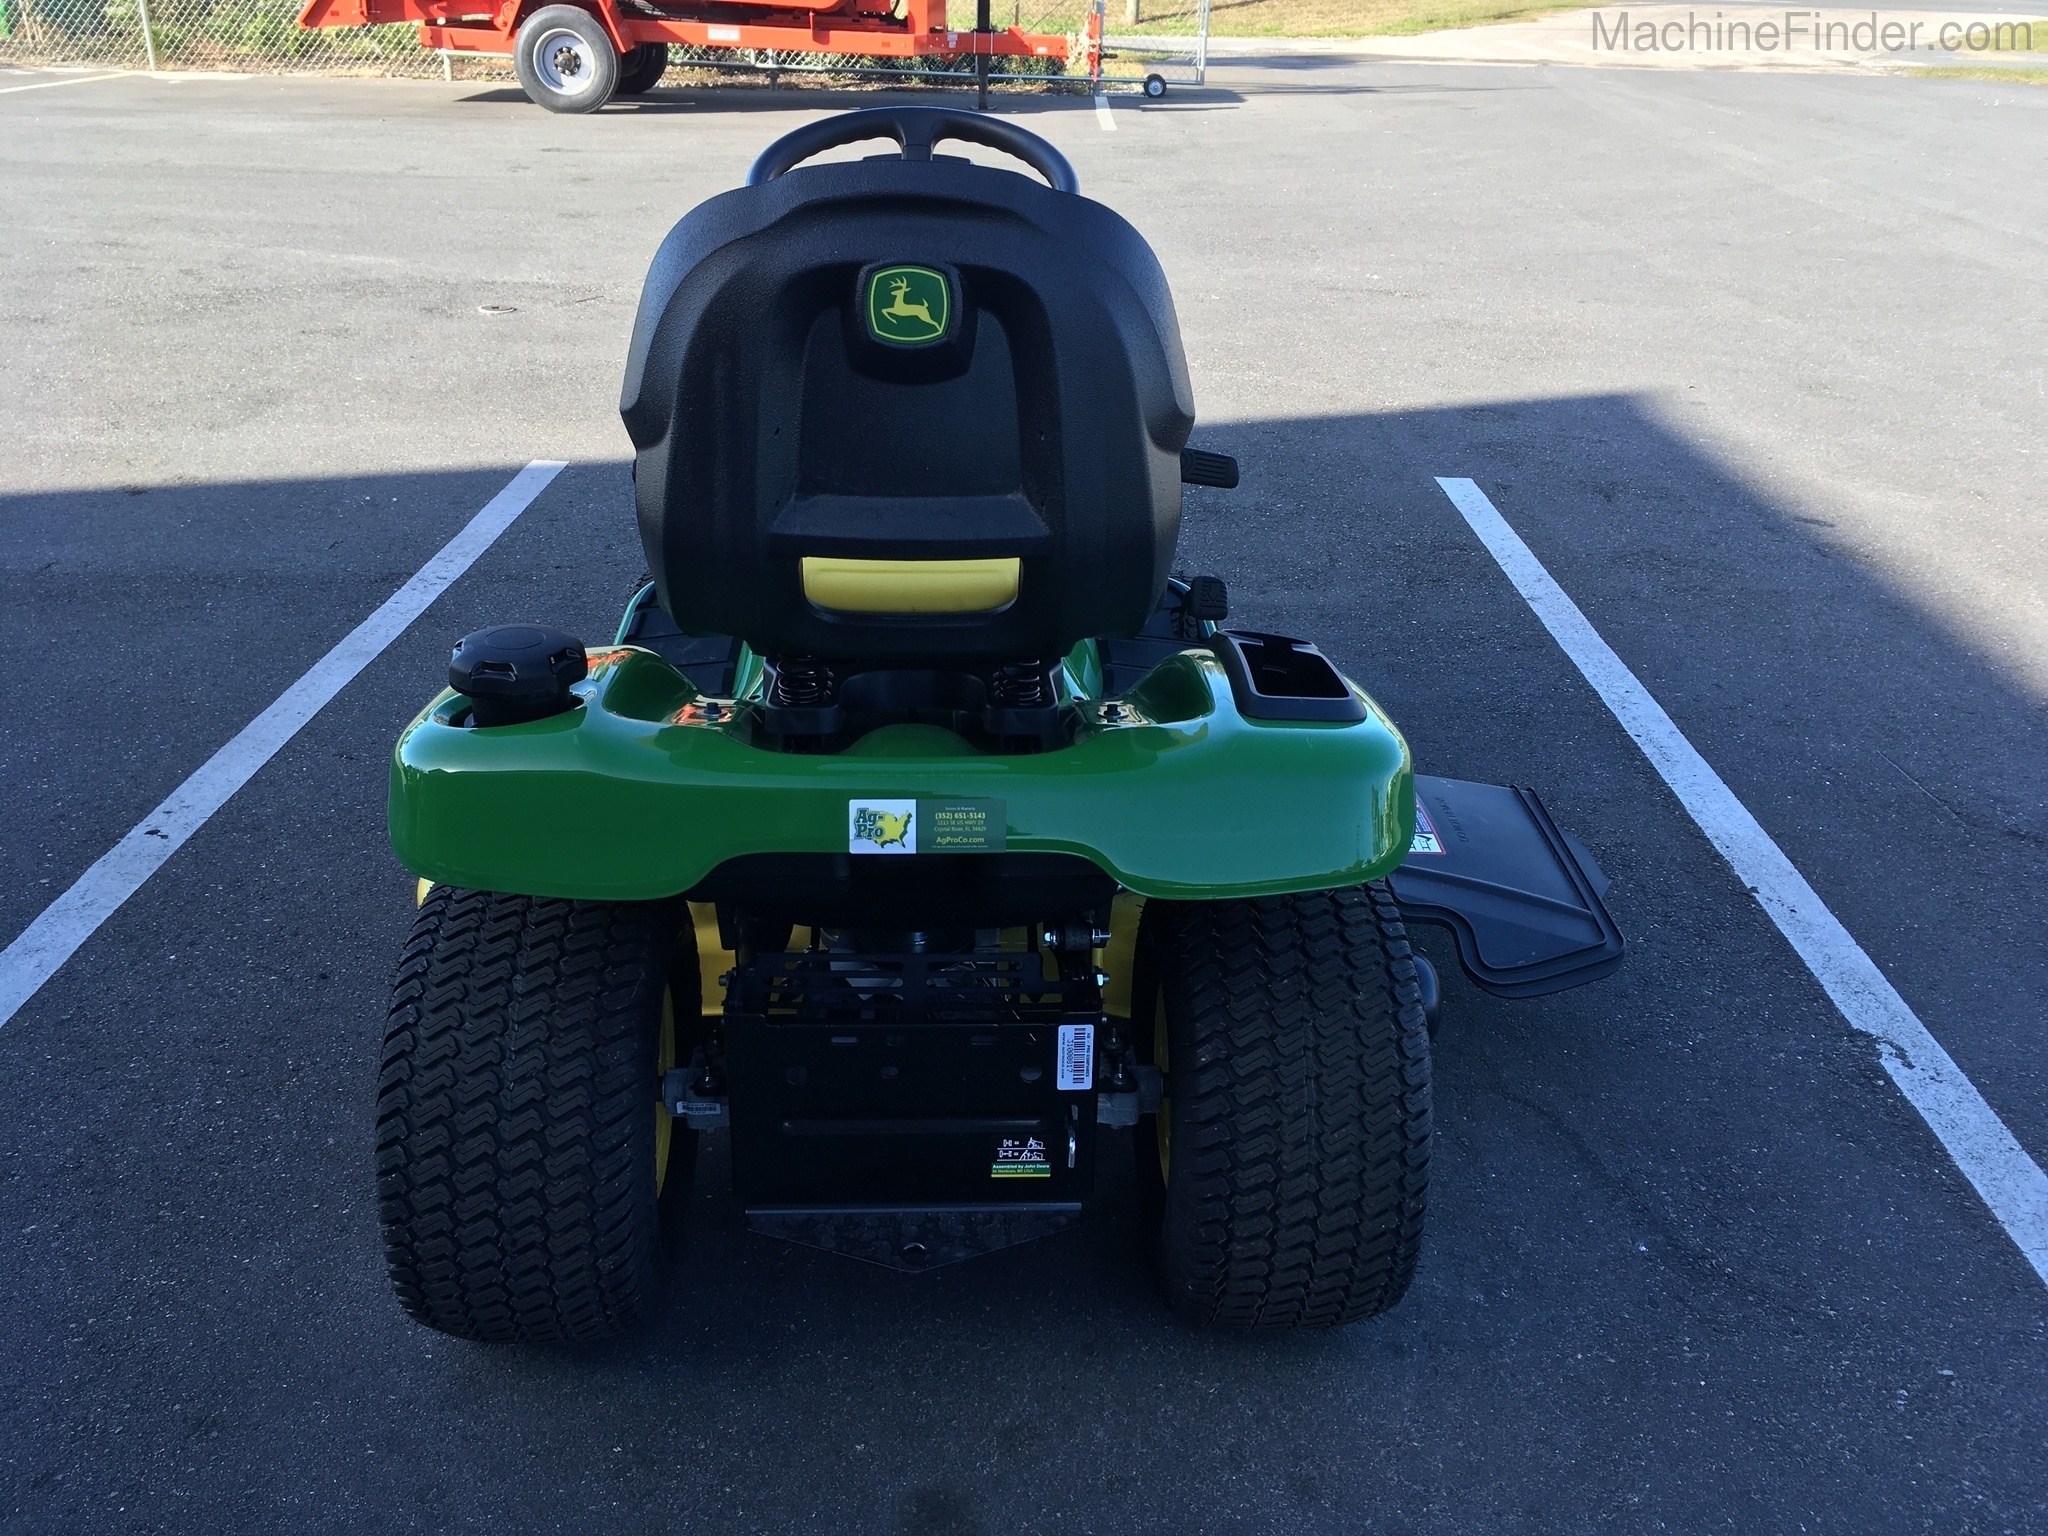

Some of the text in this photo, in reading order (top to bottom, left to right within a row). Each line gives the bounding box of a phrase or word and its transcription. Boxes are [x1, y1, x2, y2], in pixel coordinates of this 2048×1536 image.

[855, 808, 884, 826] Ag-
[935, 812, 953, 820] (352)
[855, 823, 884, 838] Pro
[936, 836, 985, 845] AgProCo.com
